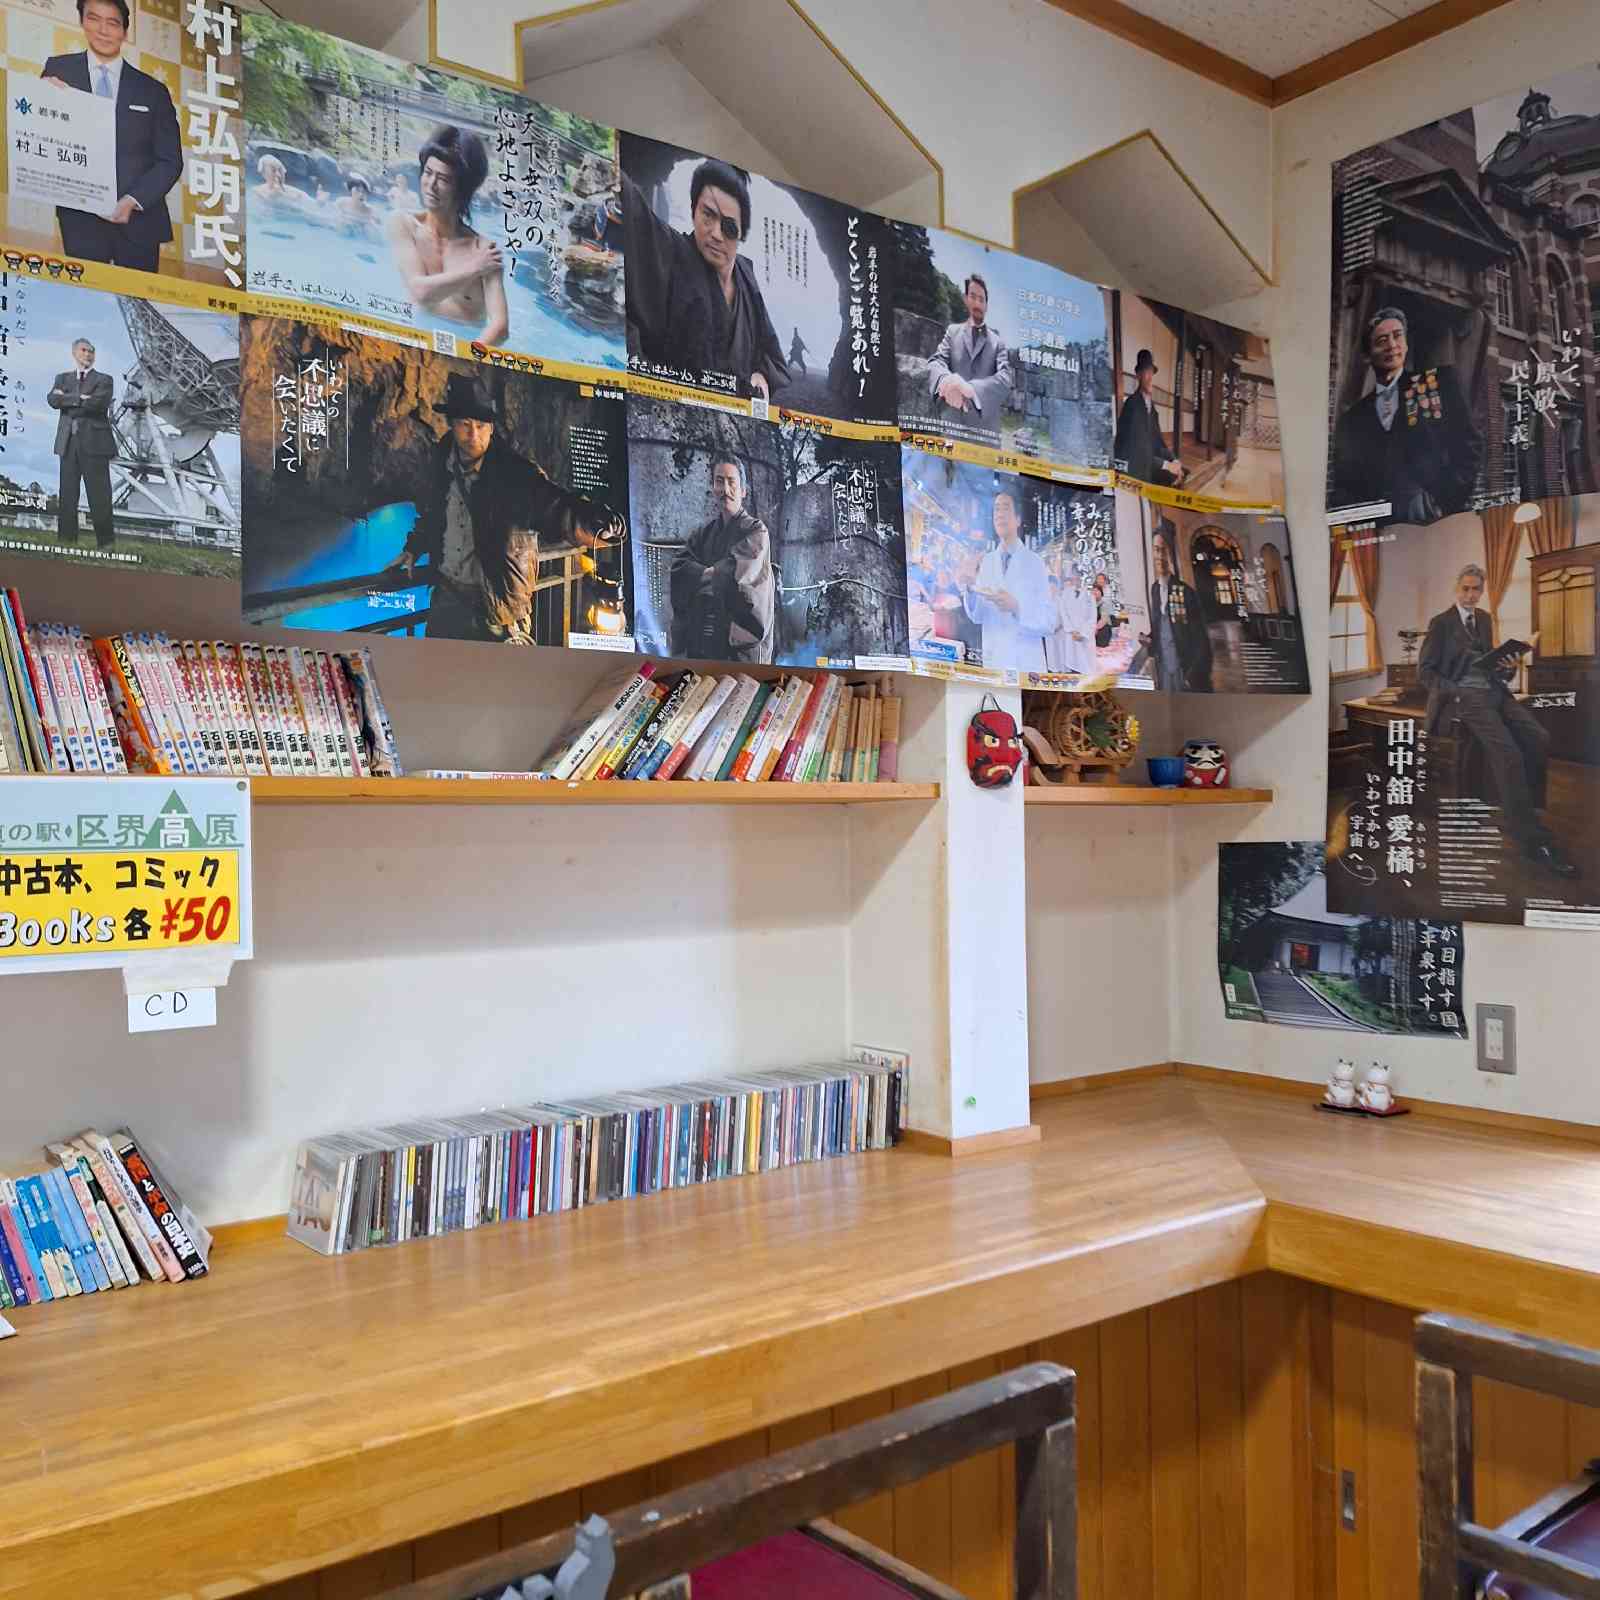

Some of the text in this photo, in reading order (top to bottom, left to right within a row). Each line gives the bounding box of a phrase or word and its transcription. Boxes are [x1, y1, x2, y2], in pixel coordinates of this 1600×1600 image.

[187, 0, 242, 289] 村上弘明氏、
[273, 374, 298, 473] 会いたくて
[301, 358, 328, 452] 不思議に
[329, 359, 342, 418] いわての
[847, 468, 865, 535] 不思議に
[864, 468, 875, 510] いわての
[1365, 772, 1382, 850] いわてから
[145, 991, 188, 1016] CD
[1417, 919, 1438, 1022] 平泉です。
